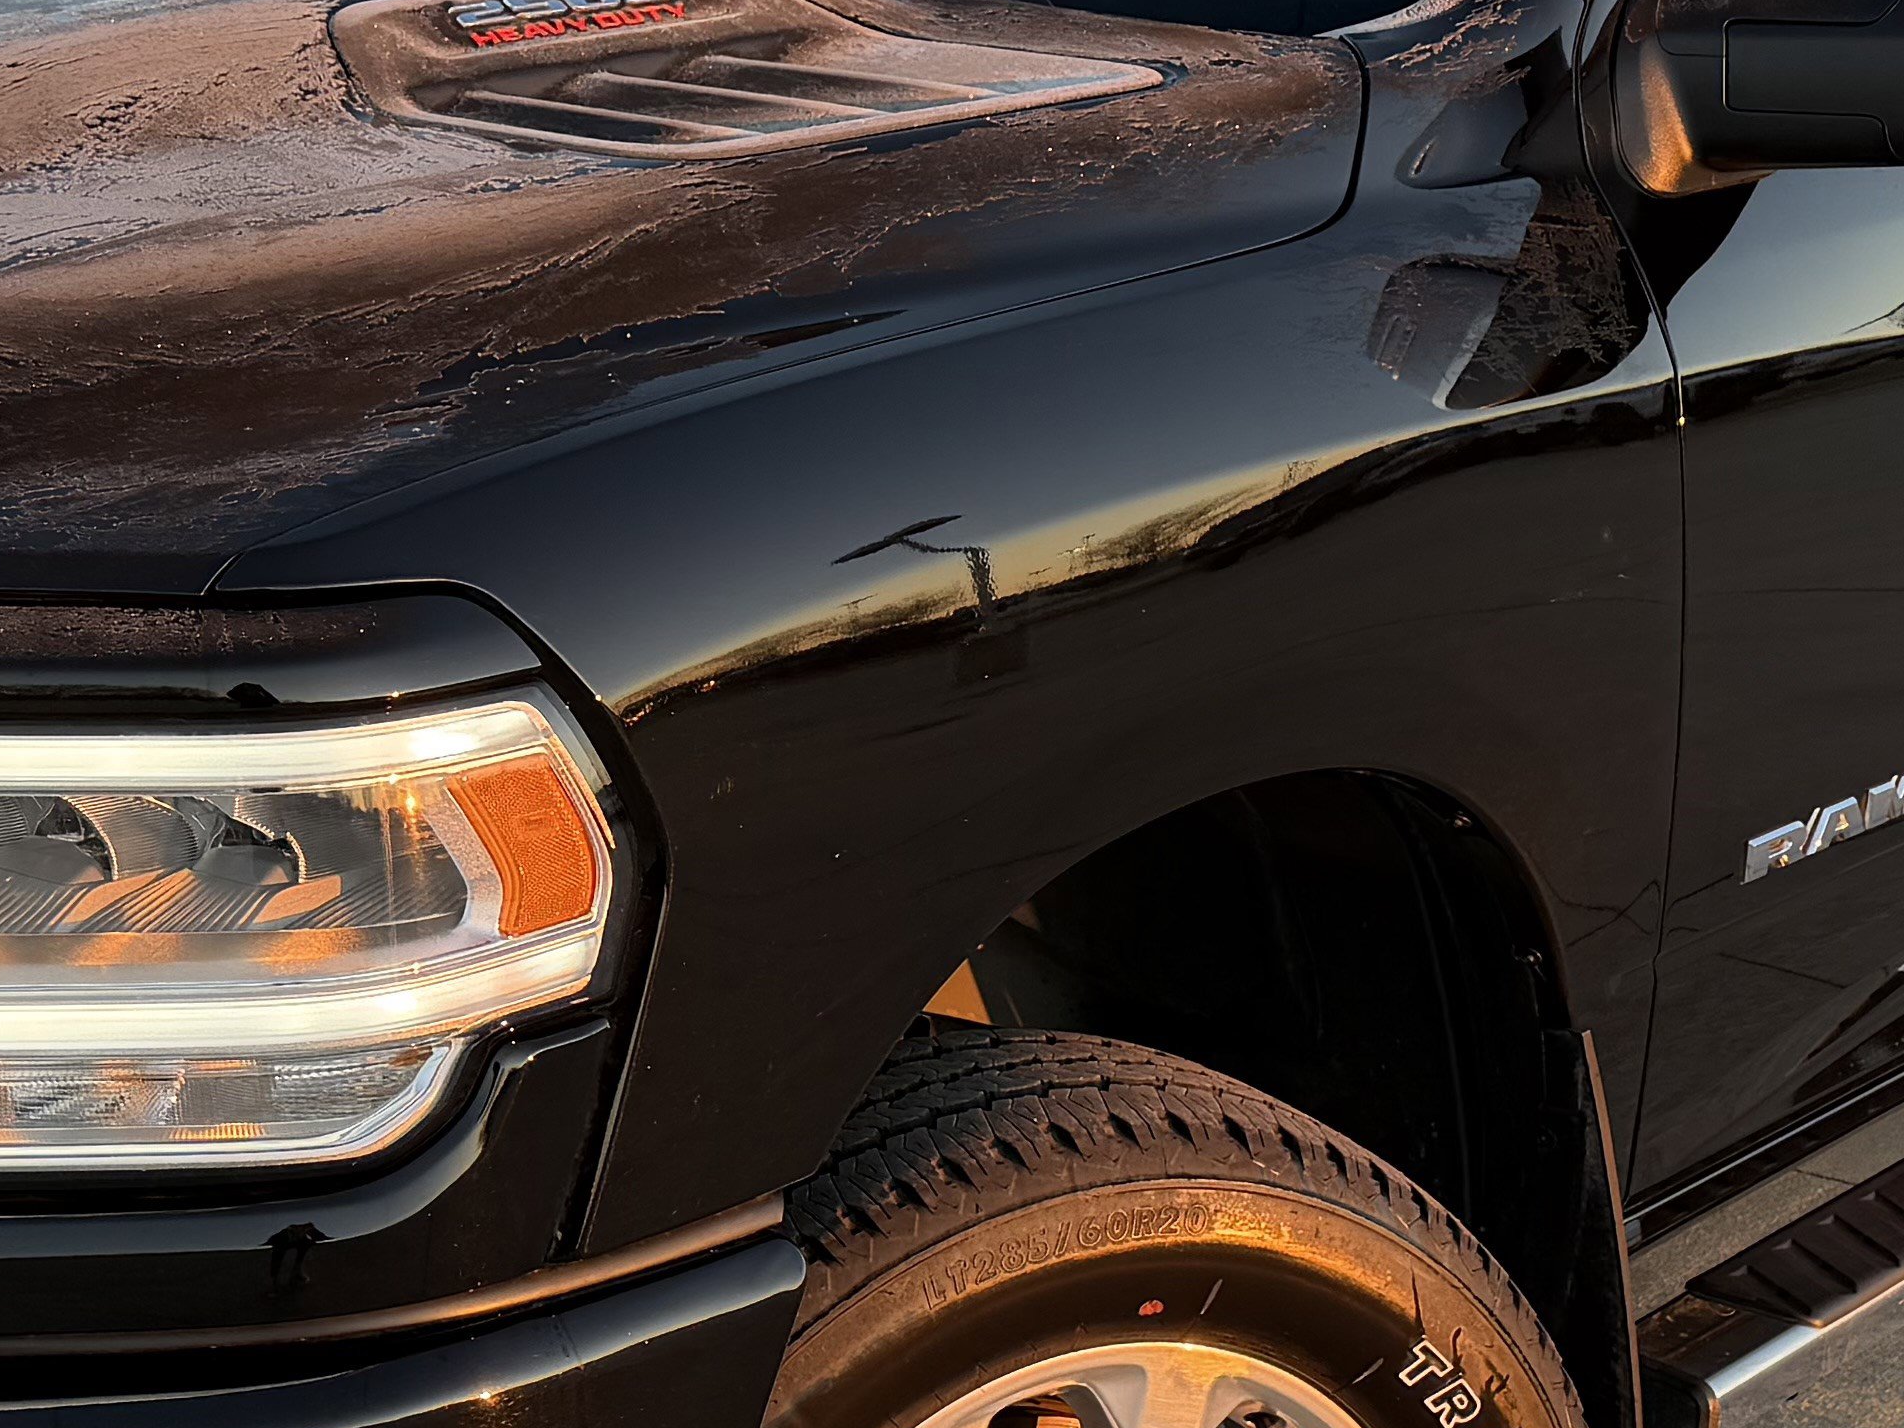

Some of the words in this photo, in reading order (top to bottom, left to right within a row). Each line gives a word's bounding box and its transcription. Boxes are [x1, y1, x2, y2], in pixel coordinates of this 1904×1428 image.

[470, 17, 590, 48] HEAVY
[593, 2, 686, 30] DUTY
[920, 1204, 1209, 1310] LT285/60R20
